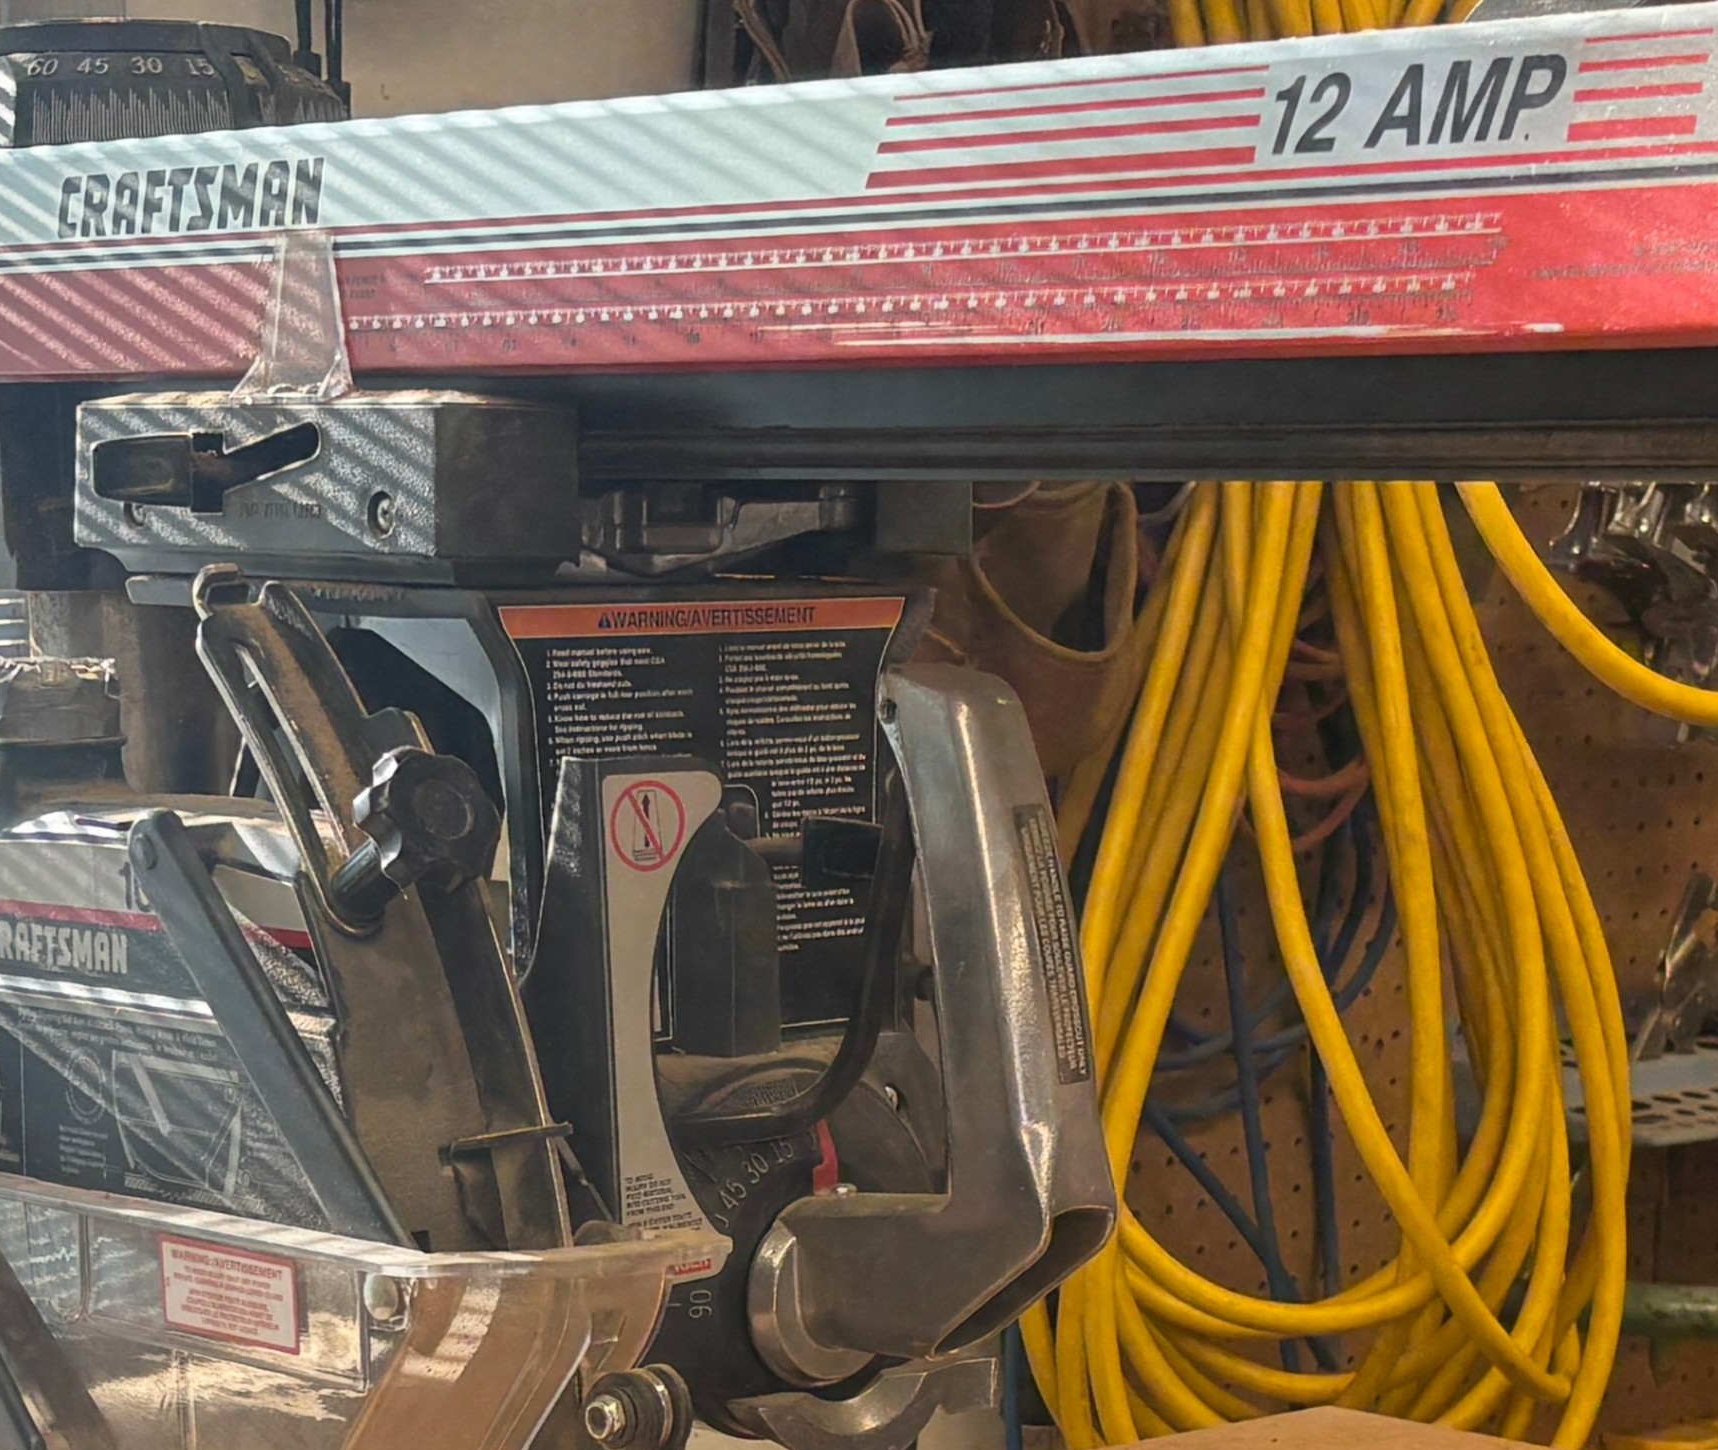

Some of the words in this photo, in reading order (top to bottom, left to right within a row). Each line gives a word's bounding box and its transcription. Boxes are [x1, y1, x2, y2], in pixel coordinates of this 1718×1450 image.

[26, 58, 58, 76] 60
[76, 57, 109, 75] 45
[131, 56, 162, 74] 30
[184, 58, 215, 77] 15
[1270, 72, 1352, 156] 12
[1365, 53, 1566, 150] AMP
[57, 157, 324, 239] CRAFTSMAN
[612, 606, 816, 629] WARNING/AVERTISSEMENT
[770, 1139, 794, 1164] 15
[742, 1153, 769, 1184] 30
[719, 1177, 748, 1211] 45
[689, 1289, 712, 1318] 90
